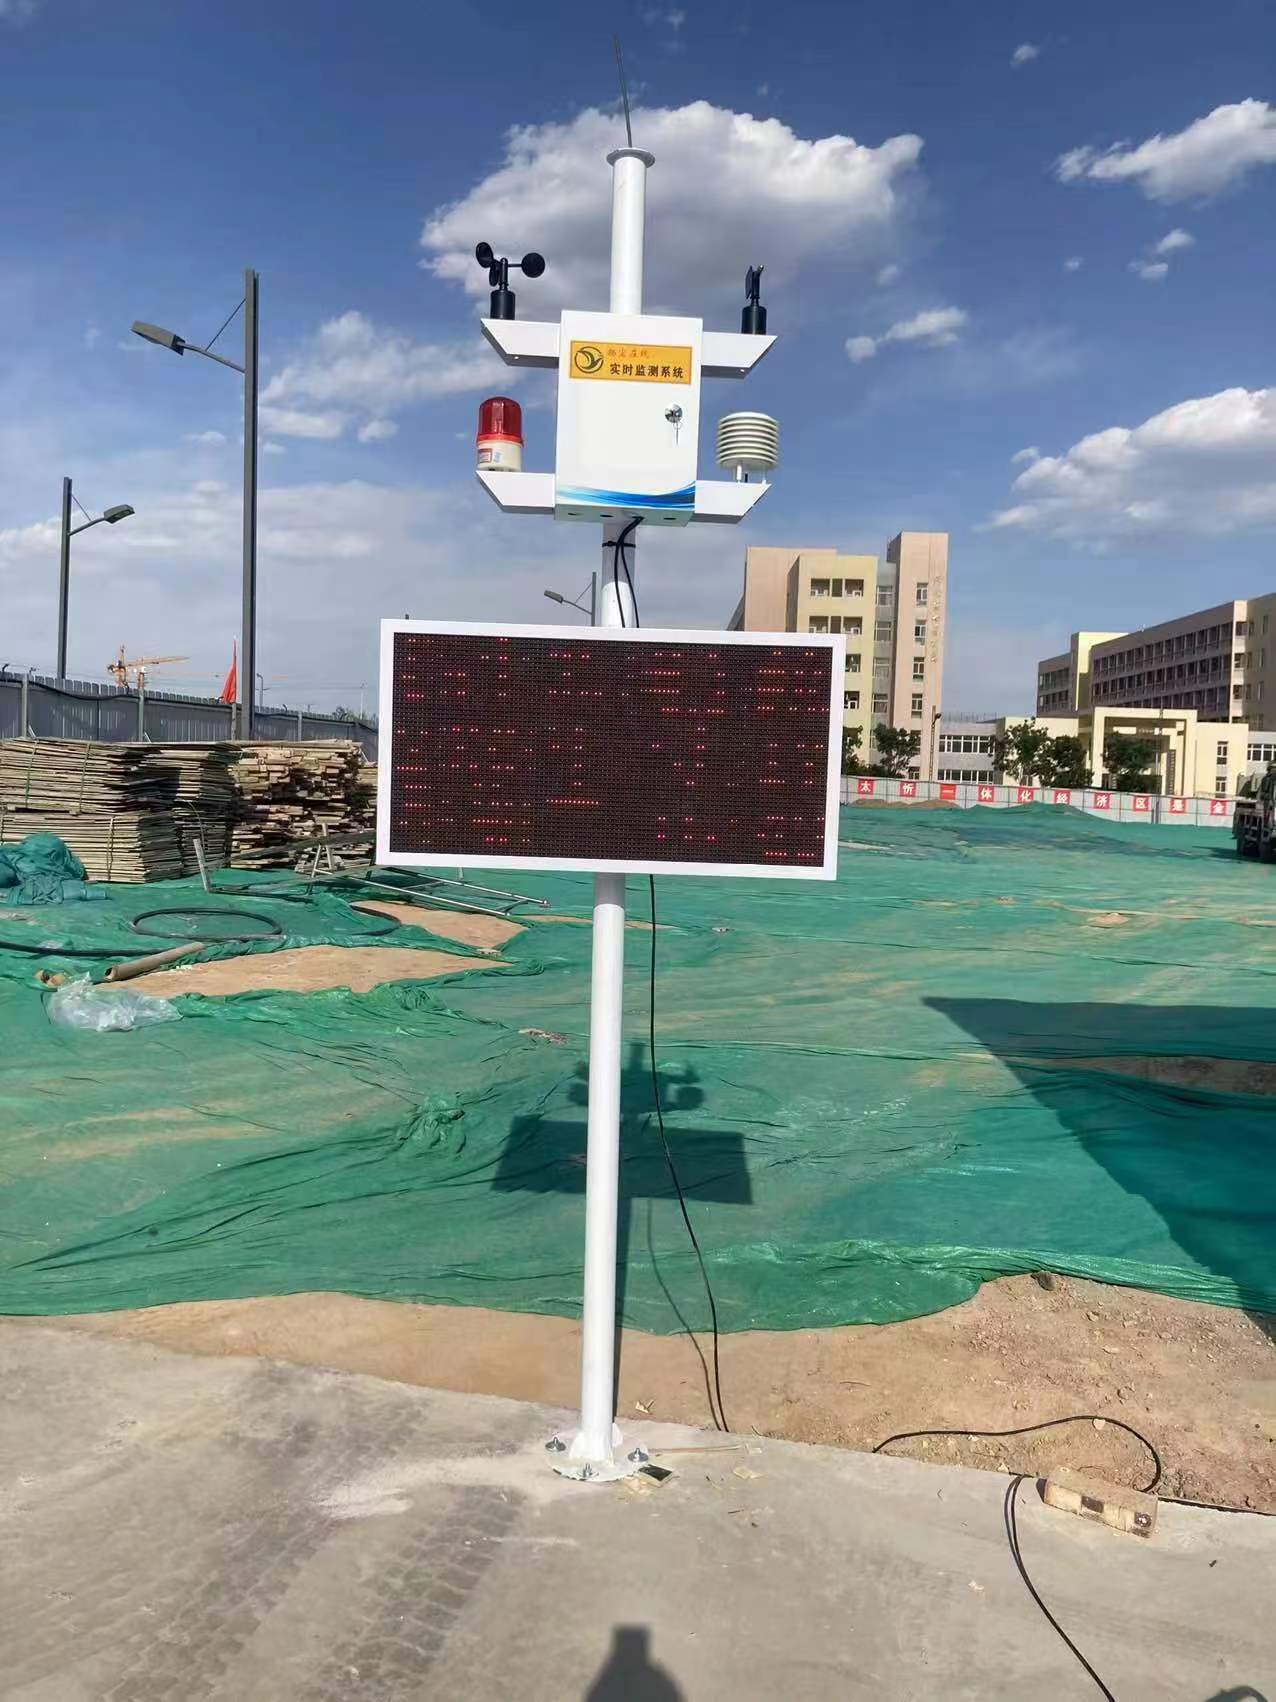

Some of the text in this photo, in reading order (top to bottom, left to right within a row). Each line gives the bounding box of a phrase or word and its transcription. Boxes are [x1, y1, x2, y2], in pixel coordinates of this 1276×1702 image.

[609, 362, 684, 379] 实时监测系统
